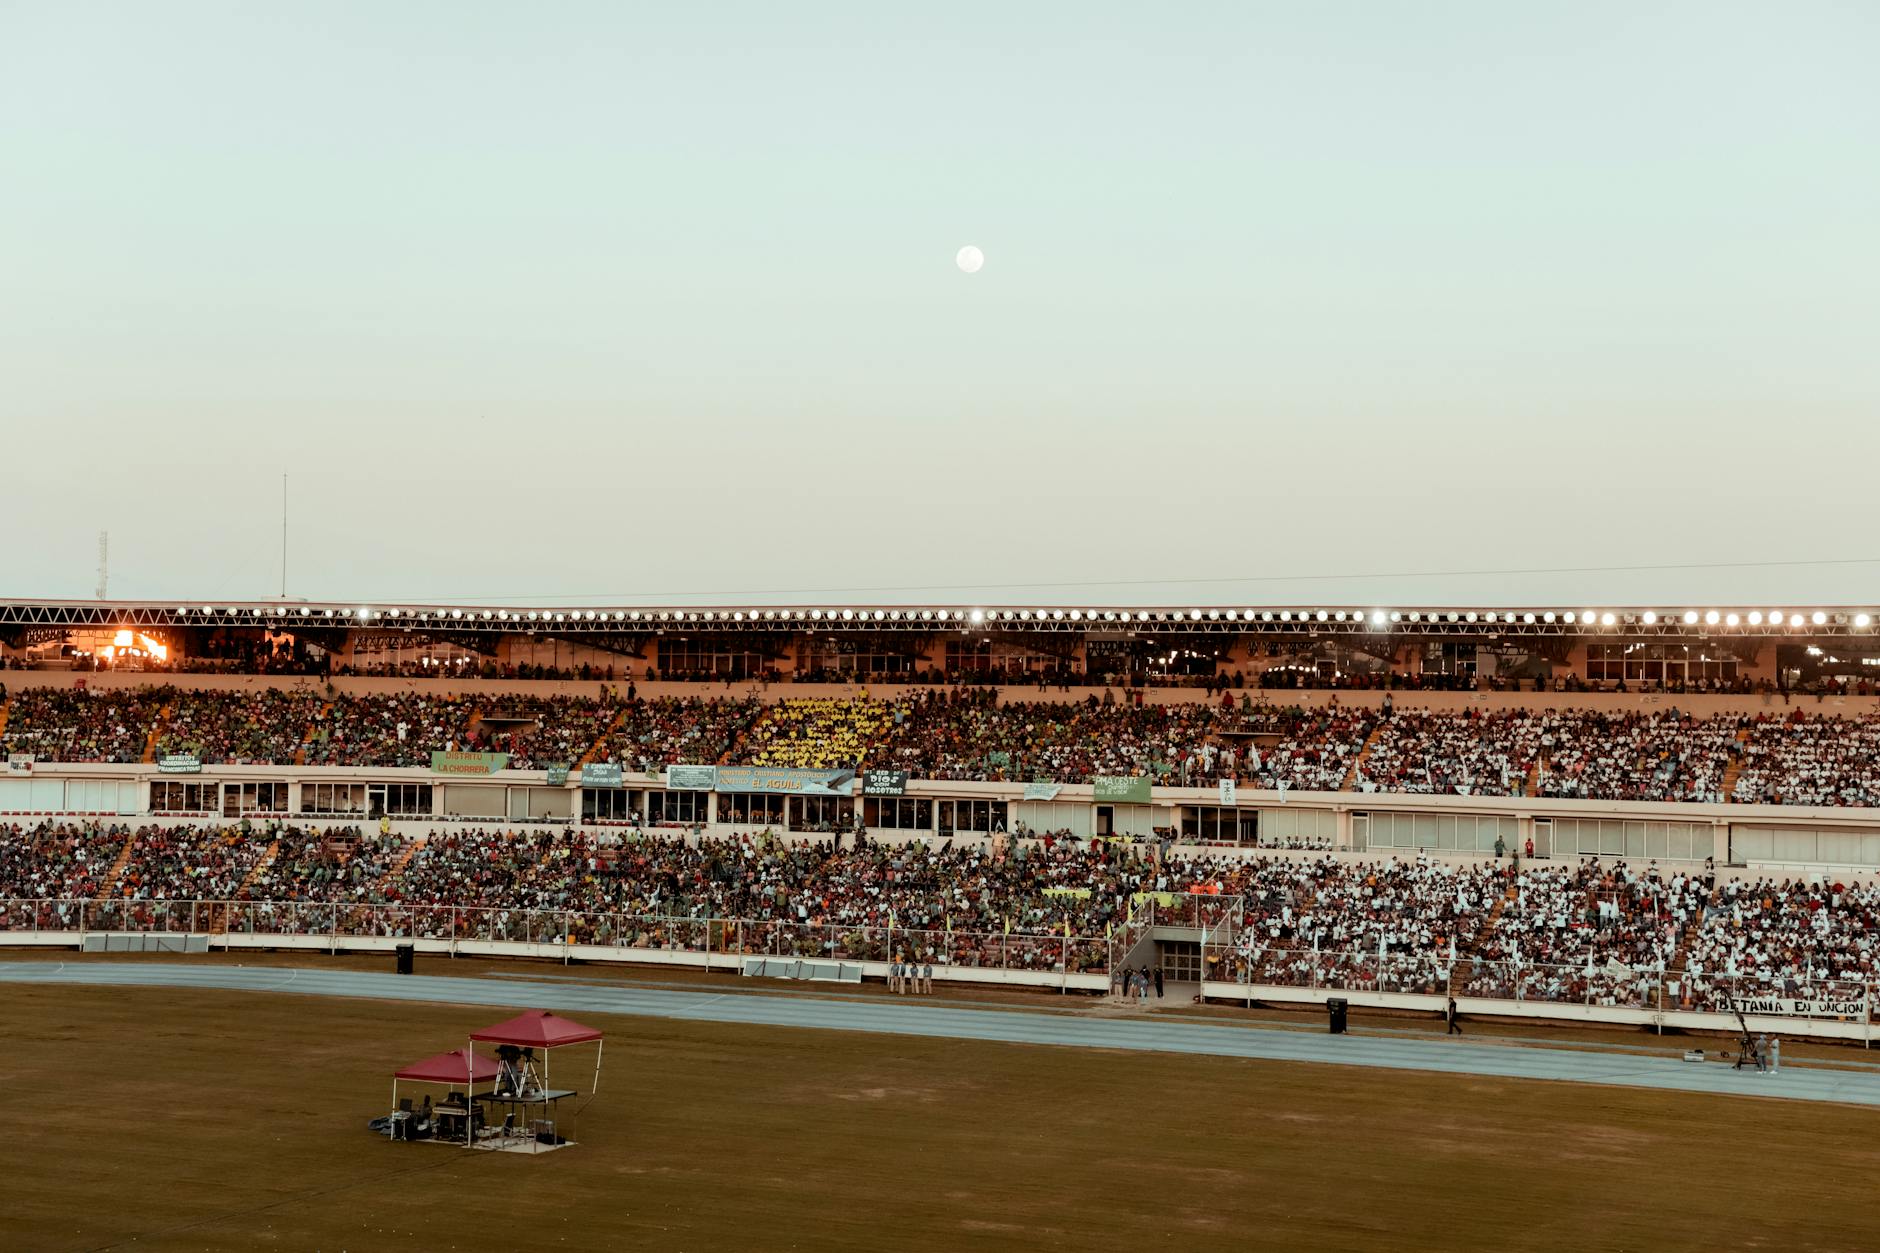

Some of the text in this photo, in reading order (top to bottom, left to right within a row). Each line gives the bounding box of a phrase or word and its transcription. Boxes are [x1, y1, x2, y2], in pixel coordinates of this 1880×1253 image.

[449, 764, 490, 774] CHORRERA
[870, 774, 899, 783] DIOS
[865, 786, 903, 795] NOSOTROS
[1794, 1001, 1811, 1012] EN
